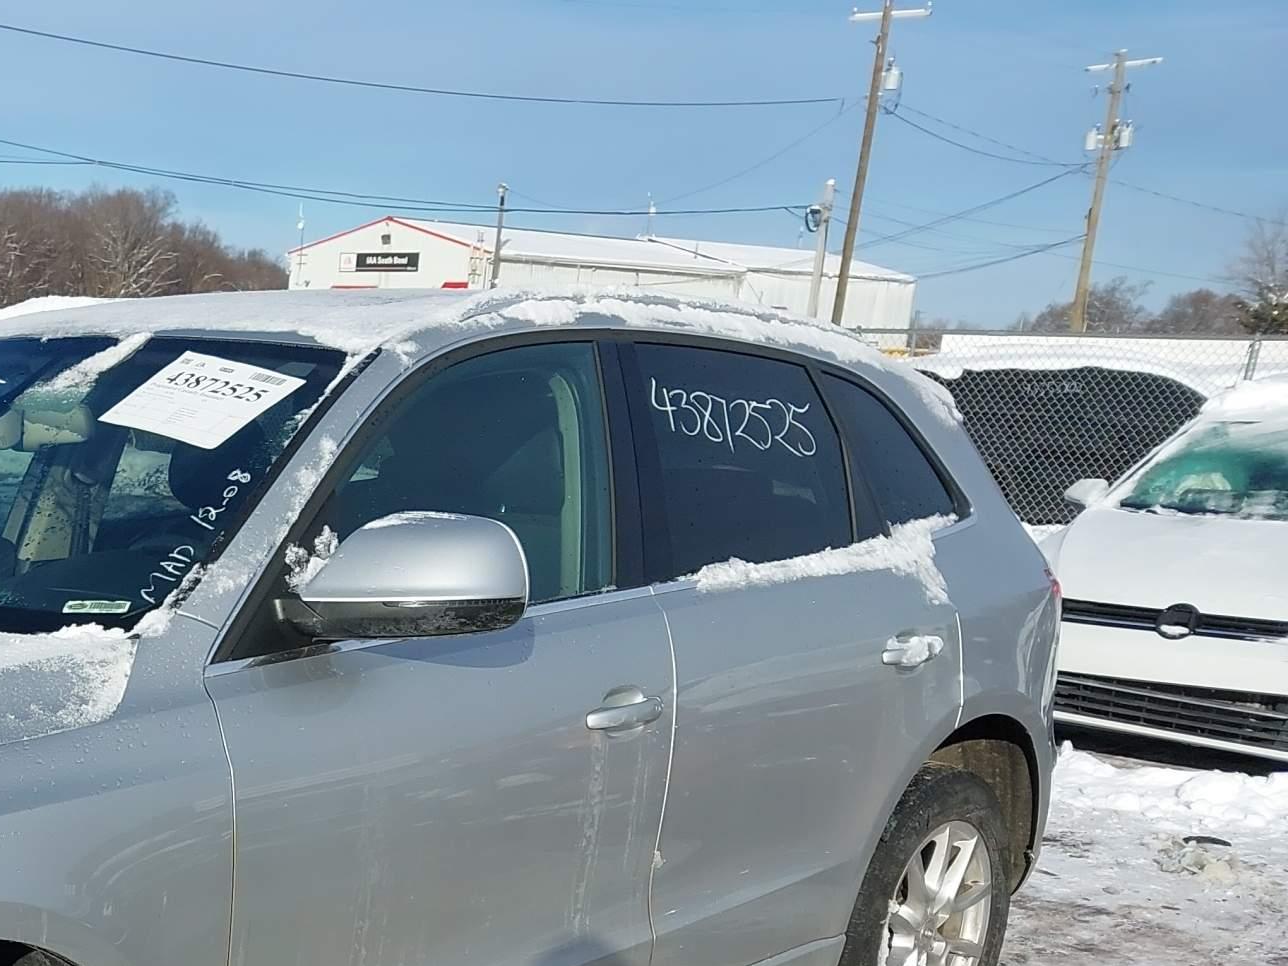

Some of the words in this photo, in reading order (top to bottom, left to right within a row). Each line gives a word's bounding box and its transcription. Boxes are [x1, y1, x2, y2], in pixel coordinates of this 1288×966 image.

[165, 370, 271, 403] 43872525
[651, 376, 817, 457] 43872525
[190, 468, 252, 531] 12-08
